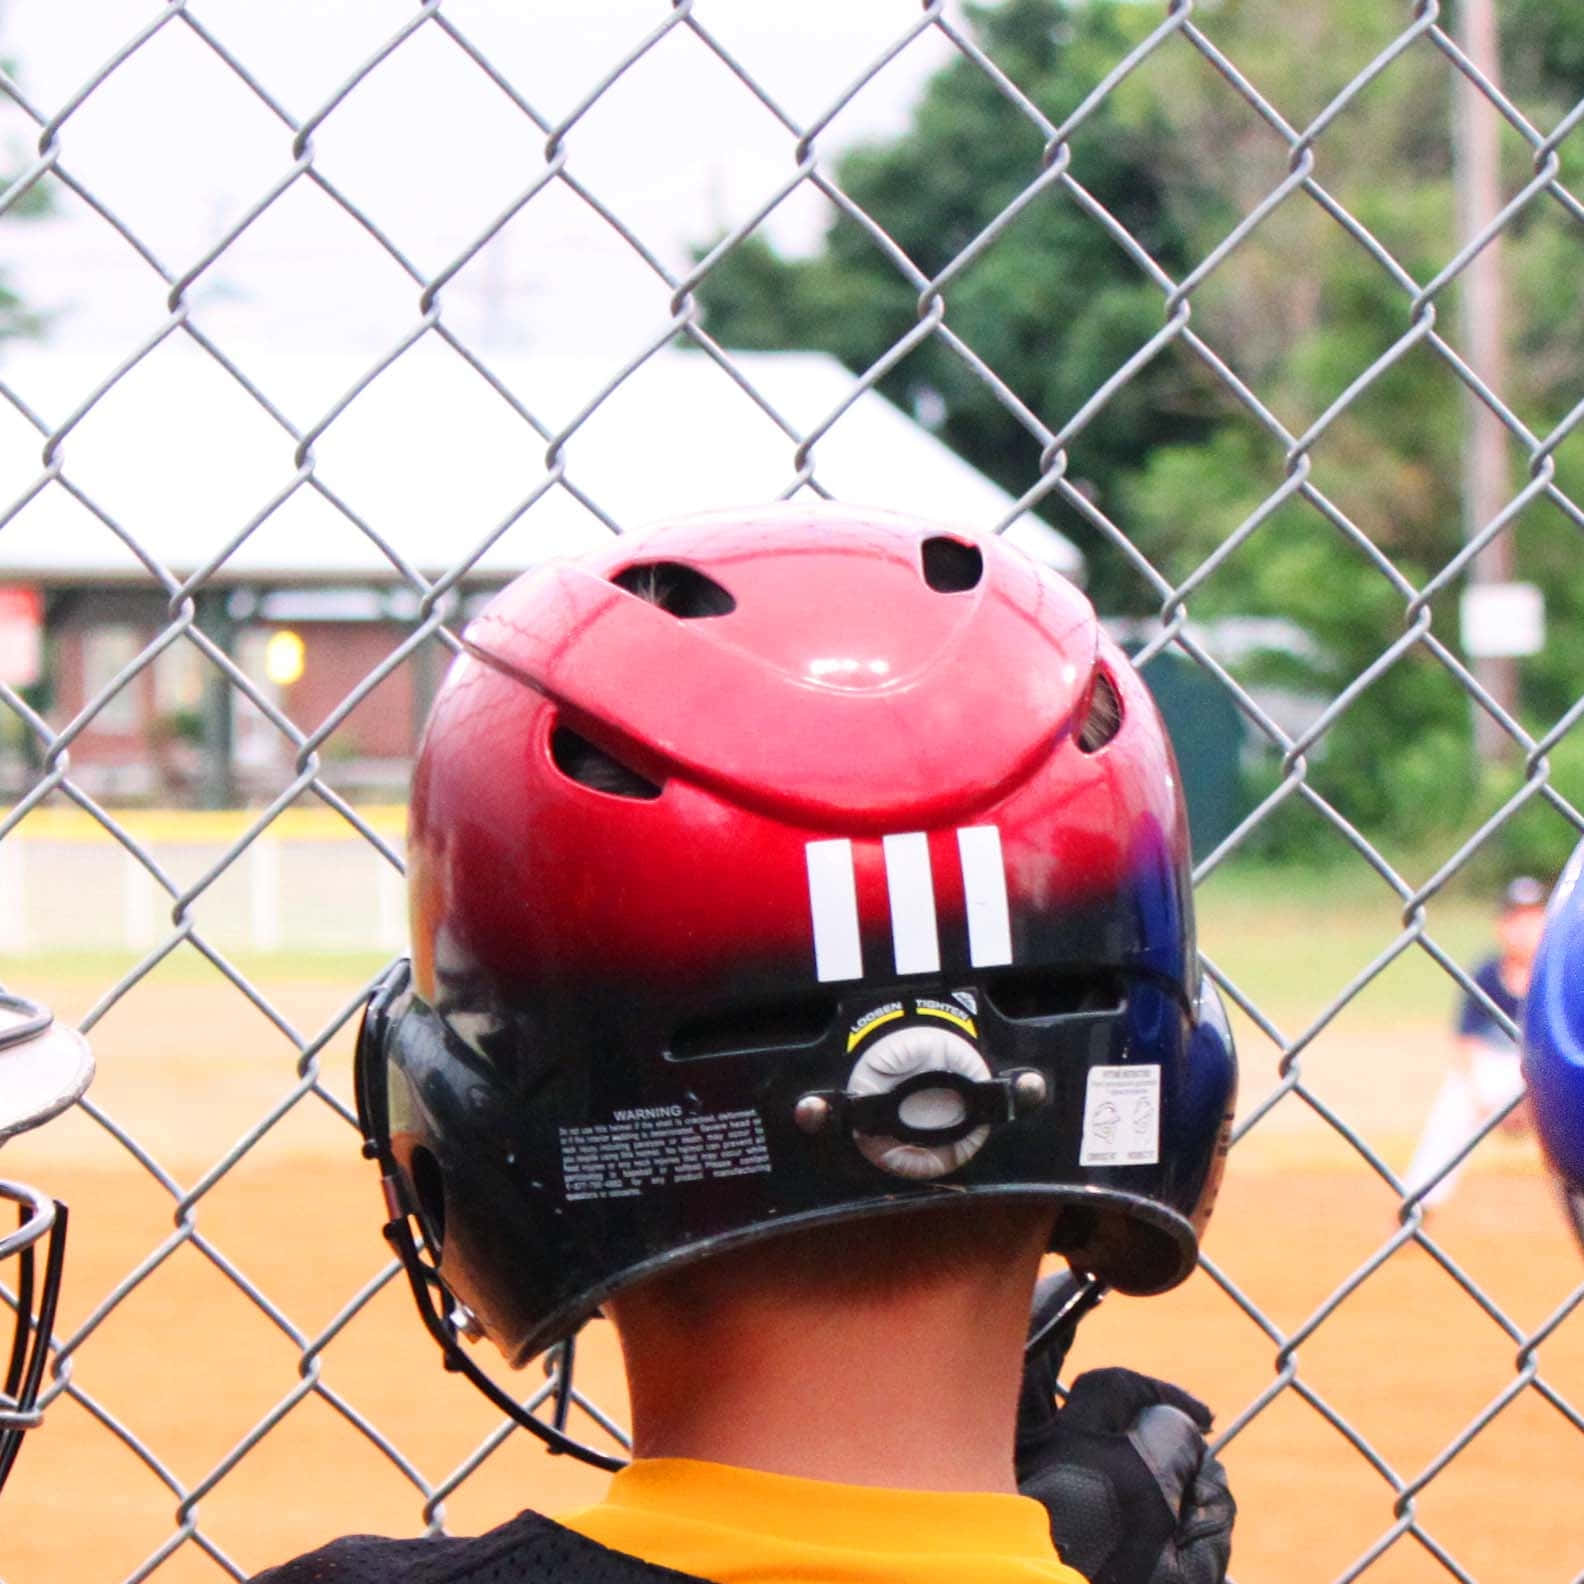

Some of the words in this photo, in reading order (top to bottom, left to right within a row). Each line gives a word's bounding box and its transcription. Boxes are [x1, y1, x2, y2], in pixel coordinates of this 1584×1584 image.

[850, 1001, 903, 1032] LOOSEN
[915, 999, 970, 1020] TIGHTEN
[613, 1105, 683, 1121] WARNING
